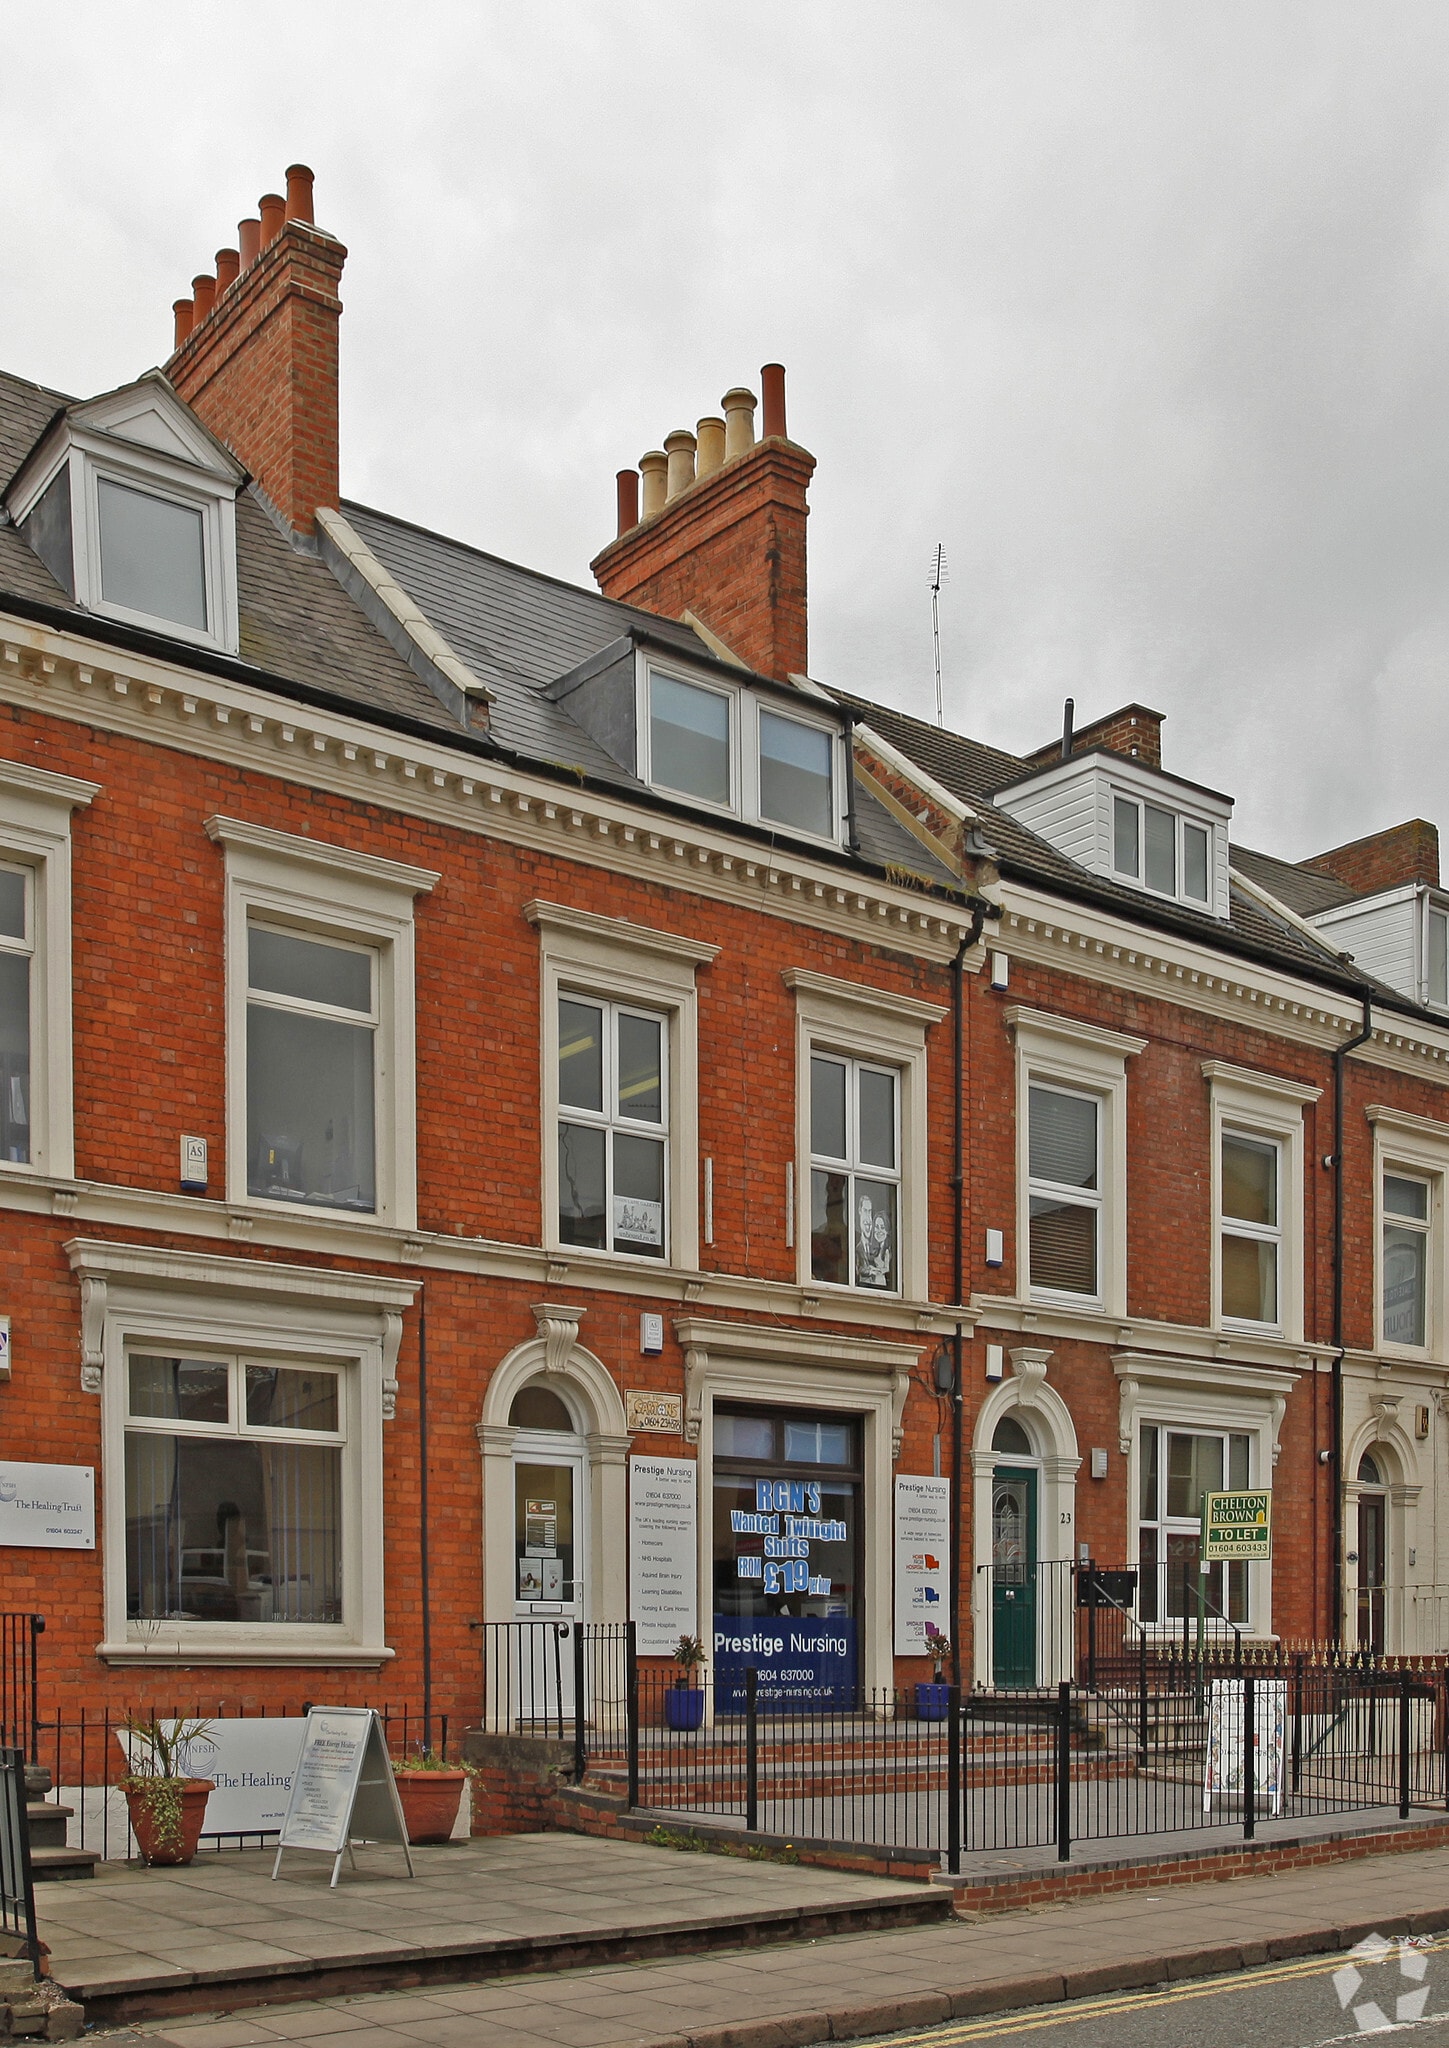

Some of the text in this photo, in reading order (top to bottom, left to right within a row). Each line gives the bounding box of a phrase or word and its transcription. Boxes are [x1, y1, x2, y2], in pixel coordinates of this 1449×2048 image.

[190, 1145, 202, 1157] AS
[634, 1400, 678, 1418] CARTOONS
[634, 1464, 692, 1478] Prestige Nursing
[899, 1483, 946, 1494] Prestige Nursing
[756, 1479, 820, 1513] RGN'S
[14, 1500, 82, 1513] The Healing Trust
[1213, 1497, 1265, 1510] CHELTON
[1061, 1513, 1071, 1523] 23
[1213, 1510, 1254, 1522] BROWN
[730, 1510, 846, 1542] Wanted Twilight
[1218, 1529, 1259, 1540] TO LET
[764, 1536, 810, 1558] Shifts
[1209, 1544, 1267, 1552] 01604 603433
[738, 1556, 762, 1578] FROM
[764, 1560, 809, 1594] £19
[714, 1633, 847, 1656] Prestige Nursing
[756, 1670, 814, 1680] 1604 637000
[191, 1745, 215, 1753] NFSH
[212, 1772, 291, 1790] The Healing
